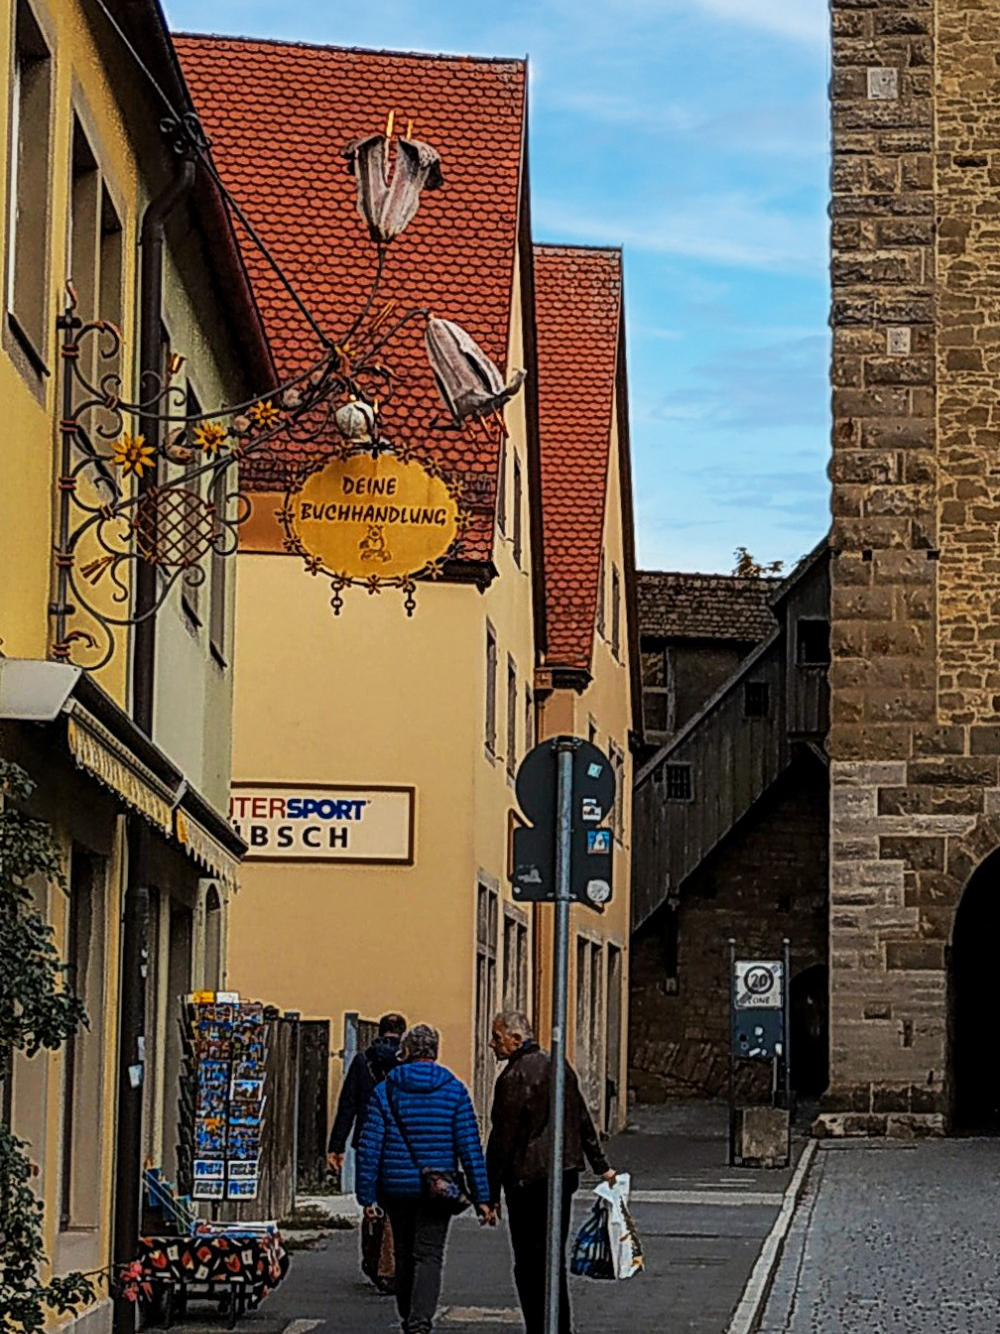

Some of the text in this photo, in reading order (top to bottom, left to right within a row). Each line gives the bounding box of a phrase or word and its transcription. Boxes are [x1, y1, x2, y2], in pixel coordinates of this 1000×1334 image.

[342, 476, 397, 495] DEINE
[300, 503, 447, 526] BUCHHANDLUNG
[750, 973, 768, 988] 20
